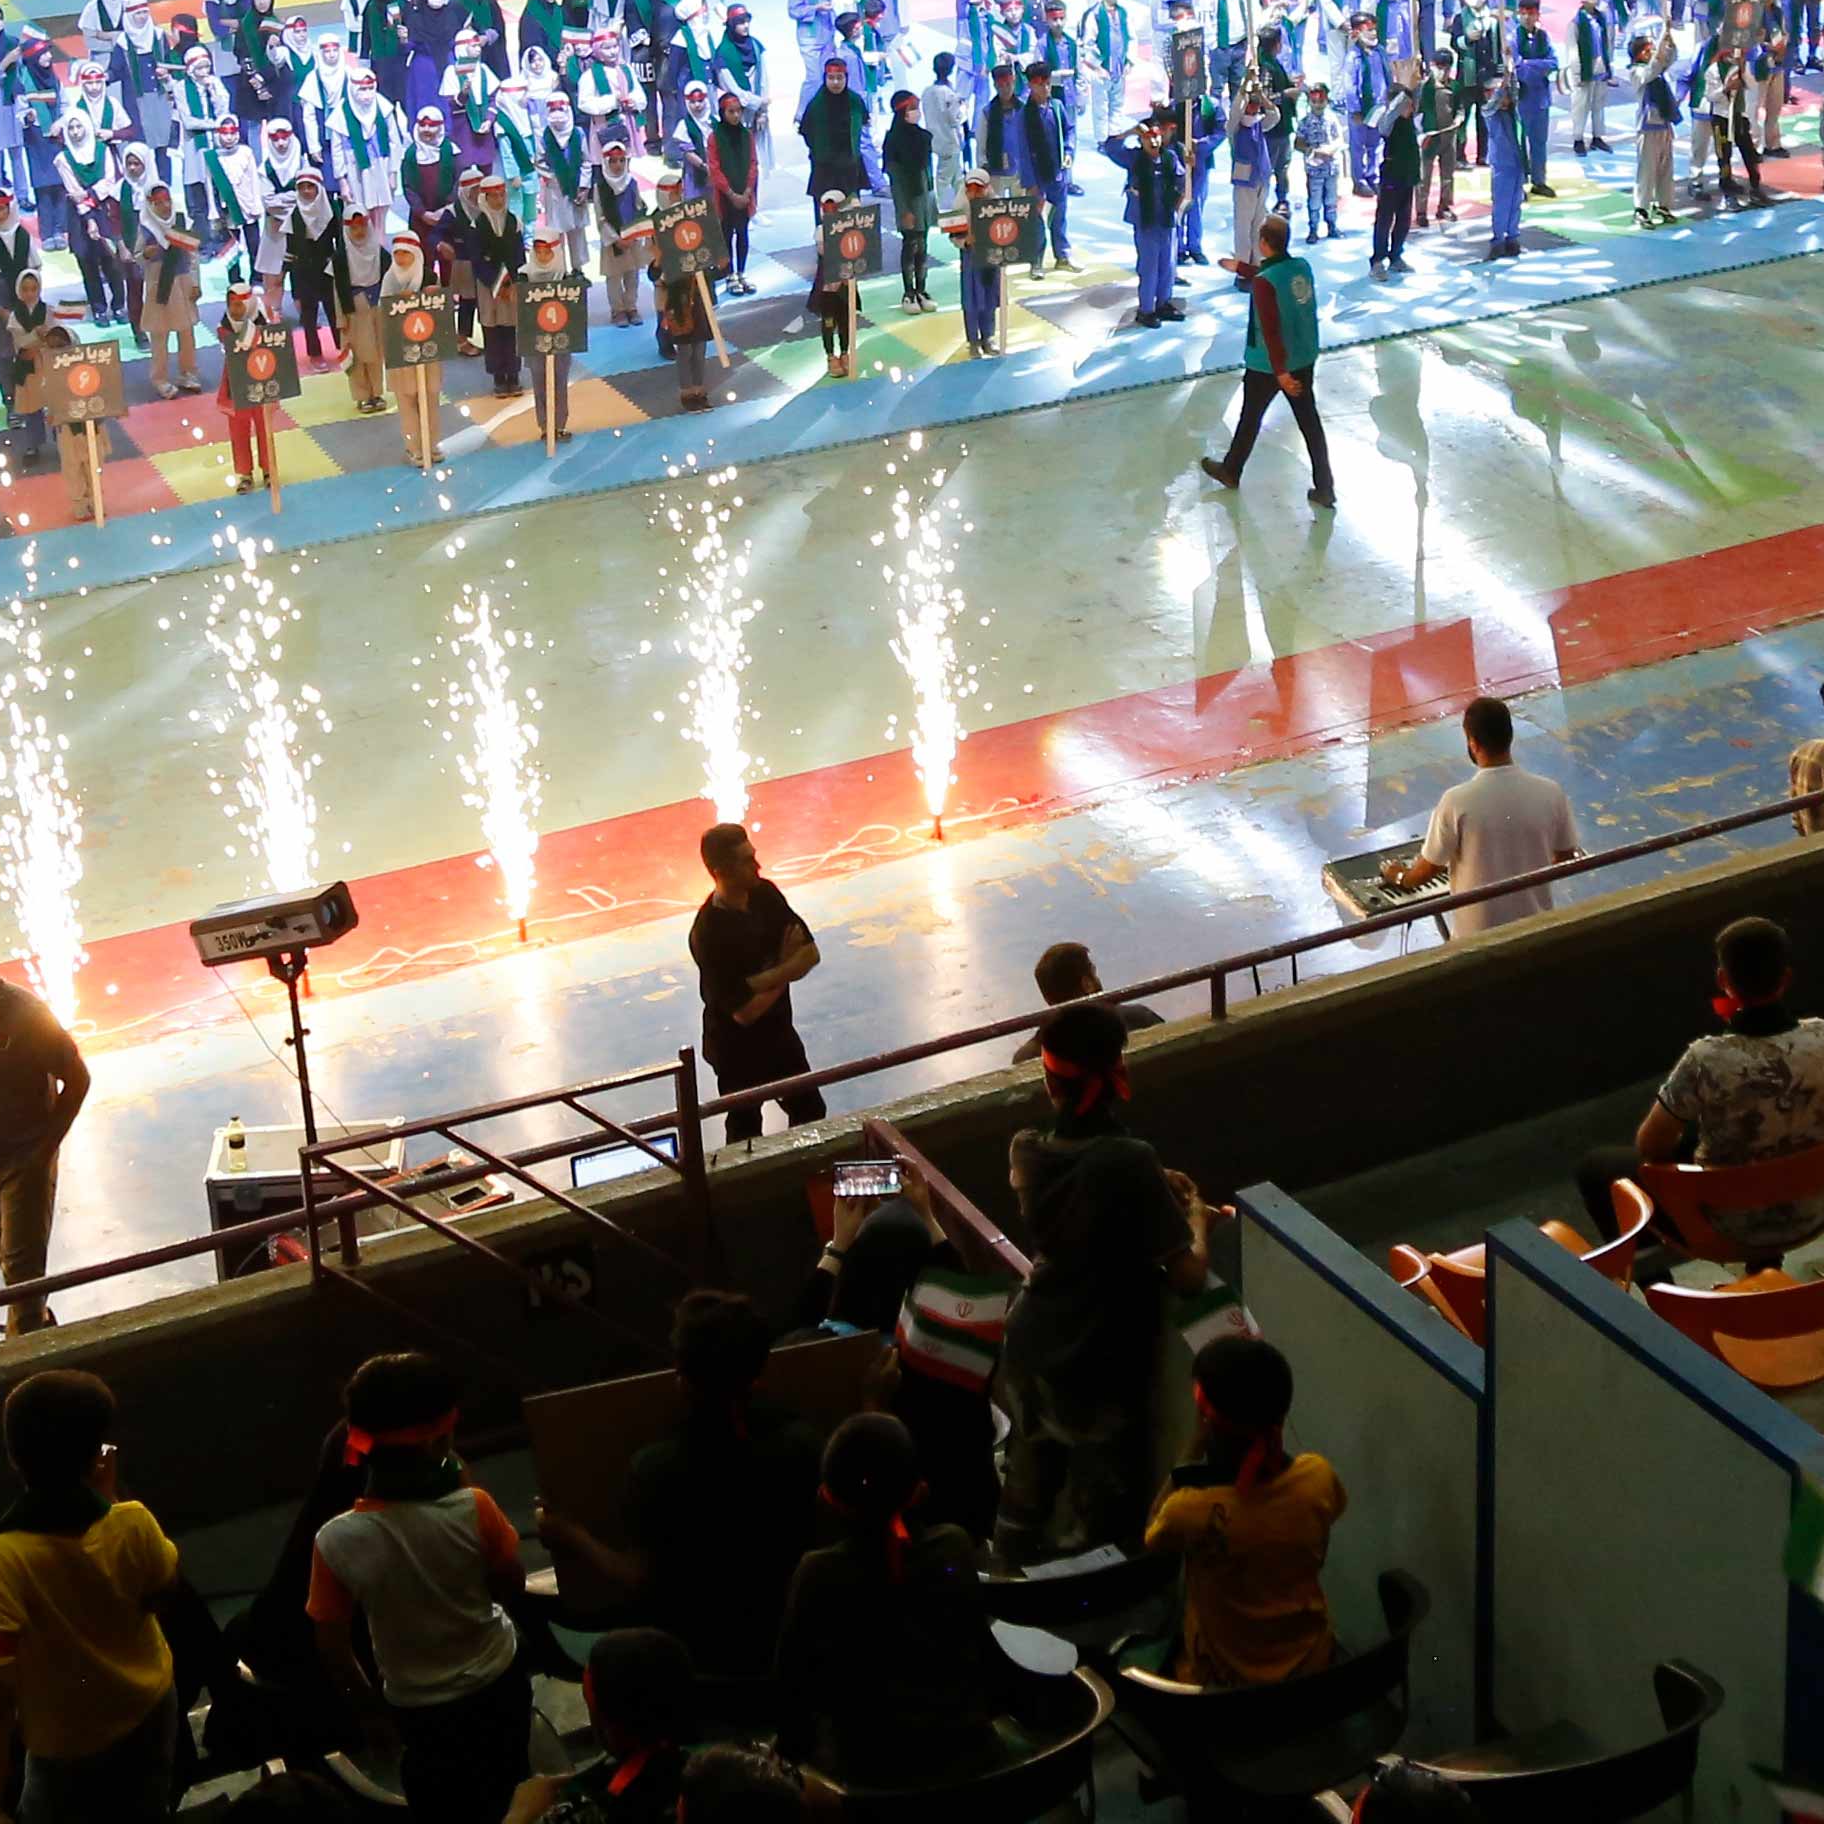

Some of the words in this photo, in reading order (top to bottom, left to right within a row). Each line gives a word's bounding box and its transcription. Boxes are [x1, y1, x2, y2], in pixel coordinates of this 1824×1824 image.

[682, 199, 708, 217] پویا
[977, 200, 1007, 219] شهر
[1007, 201, 1031, 219] پویا
[658, 209, 684, 232] شهر
[829, 214, 855, 235] شهر
[854, 211, 876, 229] پویا
[680, 228, 697, 245] ۱۰
[995, 222, 1012, 239] ۱۲
[847, 236, 859, 253] ۱۱
[420, 292, 446, 311] پویا
[524, 283, 555, 304] شهر
[555, 284, 582, 303] پویا
[389, 294, 420, 316] شهر
[545, 306, 558, 324] ۹
[412, 317, 426, 334] ۸
[52, 348, 85, 370] شهر
[84, 345, 114, 365] پویا
[254, 355, 269, 373] ۷
[78, 371, 89, 388] ۶
